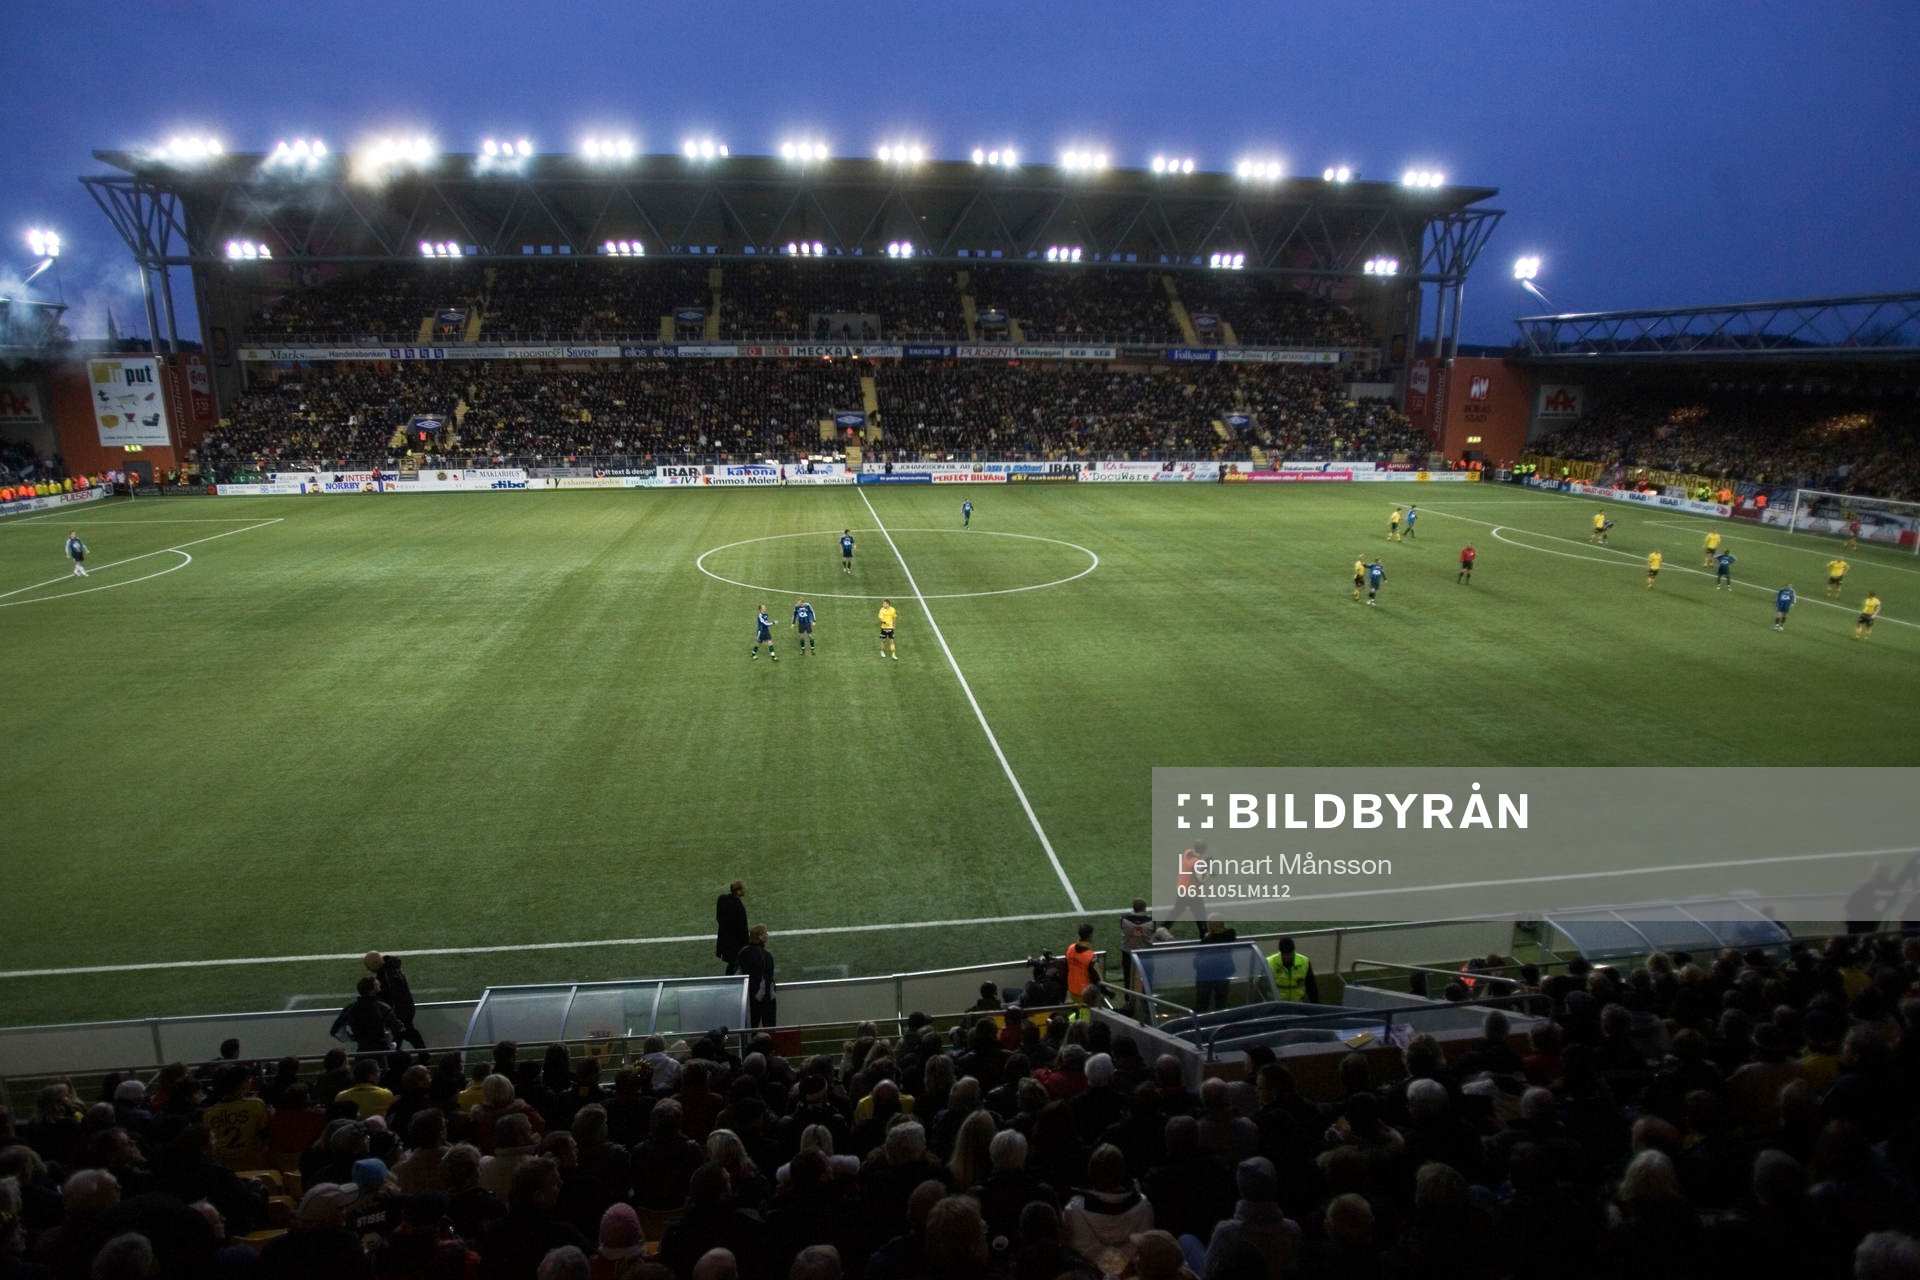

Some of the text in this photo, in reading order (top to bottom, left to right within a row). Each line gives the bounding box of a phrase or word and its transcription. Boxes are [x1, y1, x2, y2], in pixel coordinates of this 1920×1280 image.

[270, 350, 305, 360] Marks
[797, 347, 842, 356] MECKA
[1174, 350, 1211, 361] Folksam
[747, 476, 779, 485] Måleri
[933, 474, 969, 482] PERFECT
[1092, 471, 1150, 482] DocuWare
[325, 482, 361, 490] NORRBY
[228, 1126, 245, 1148] 2
